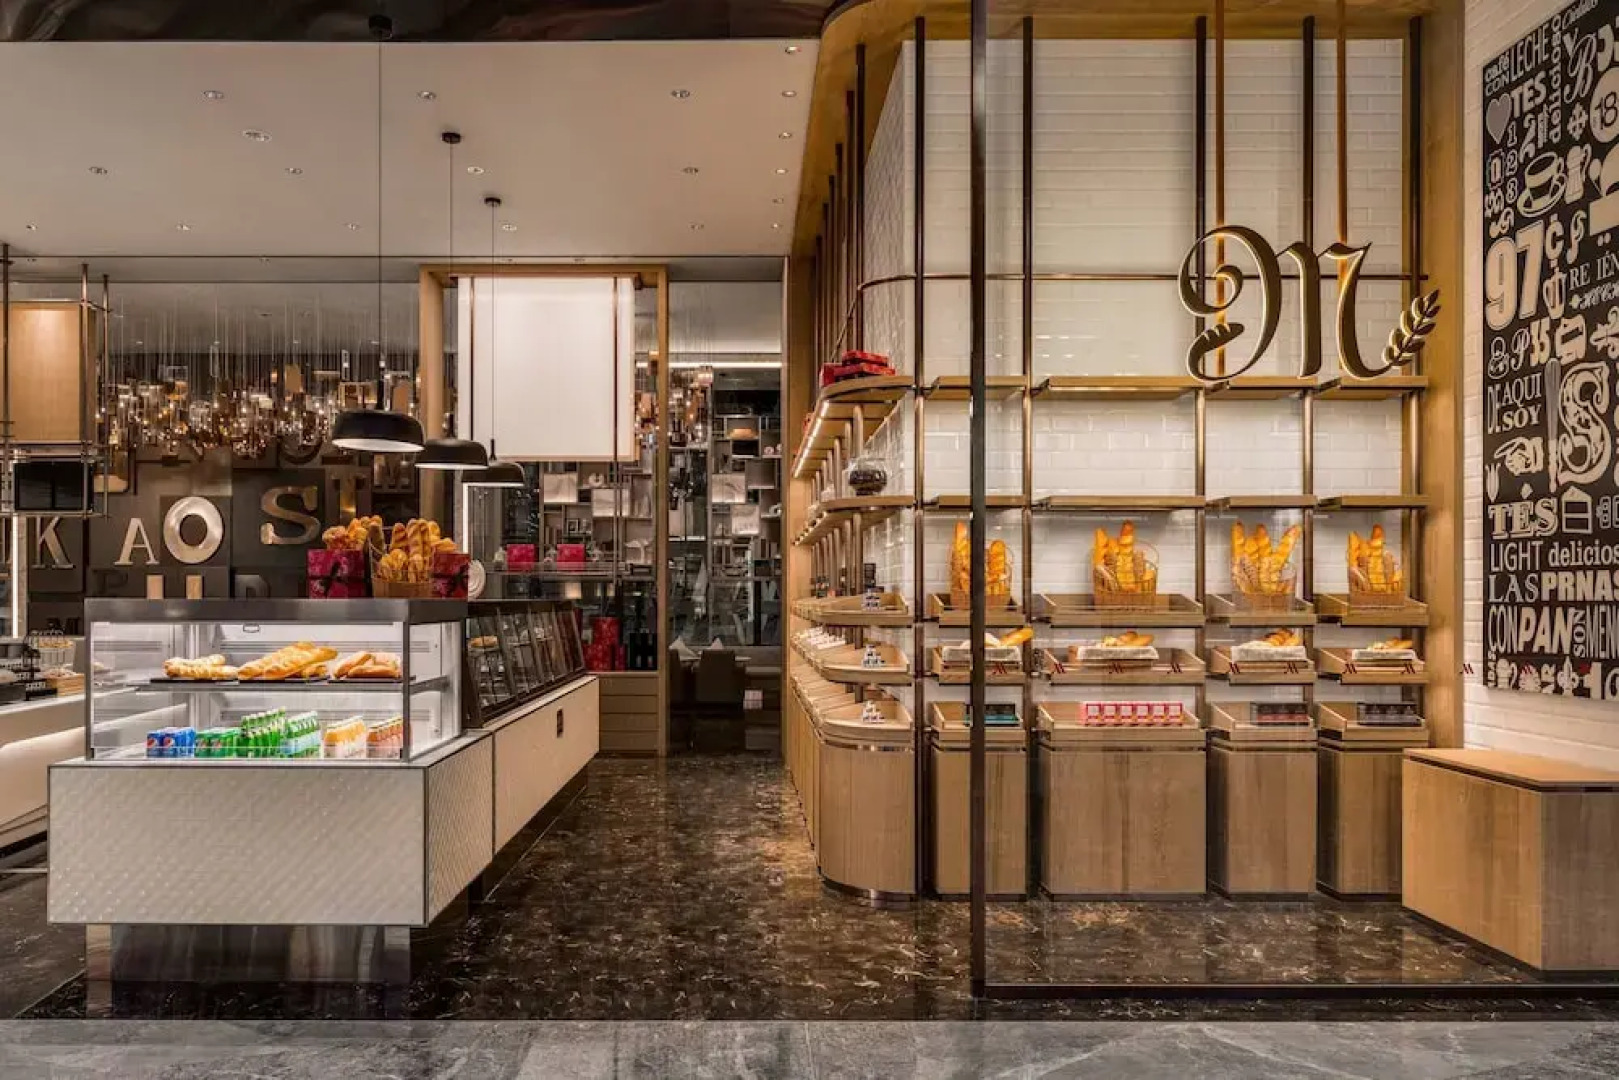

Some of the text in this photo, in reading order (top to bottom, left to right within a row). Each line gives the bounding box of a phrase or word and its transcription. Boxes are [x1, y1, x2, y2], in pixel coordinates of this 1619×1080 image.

[1510, 22, 1550, 82] LECHE
[1486, 219, 1545, 330] 97
[1502, 403, 1542, 432] SOY
[31, 514, 75, 569] K
[114, 517, 161, 566] A
[163, 496, 224, 564] O
[1490, 540, 1544, 572] LIGHT
[1488, 572, 1539, 602] LAS
[1488, 605, 1518, 655] CON
[1518, 605, 1575, 656] PAN
[1586, 603, 1619, 660] MEN
